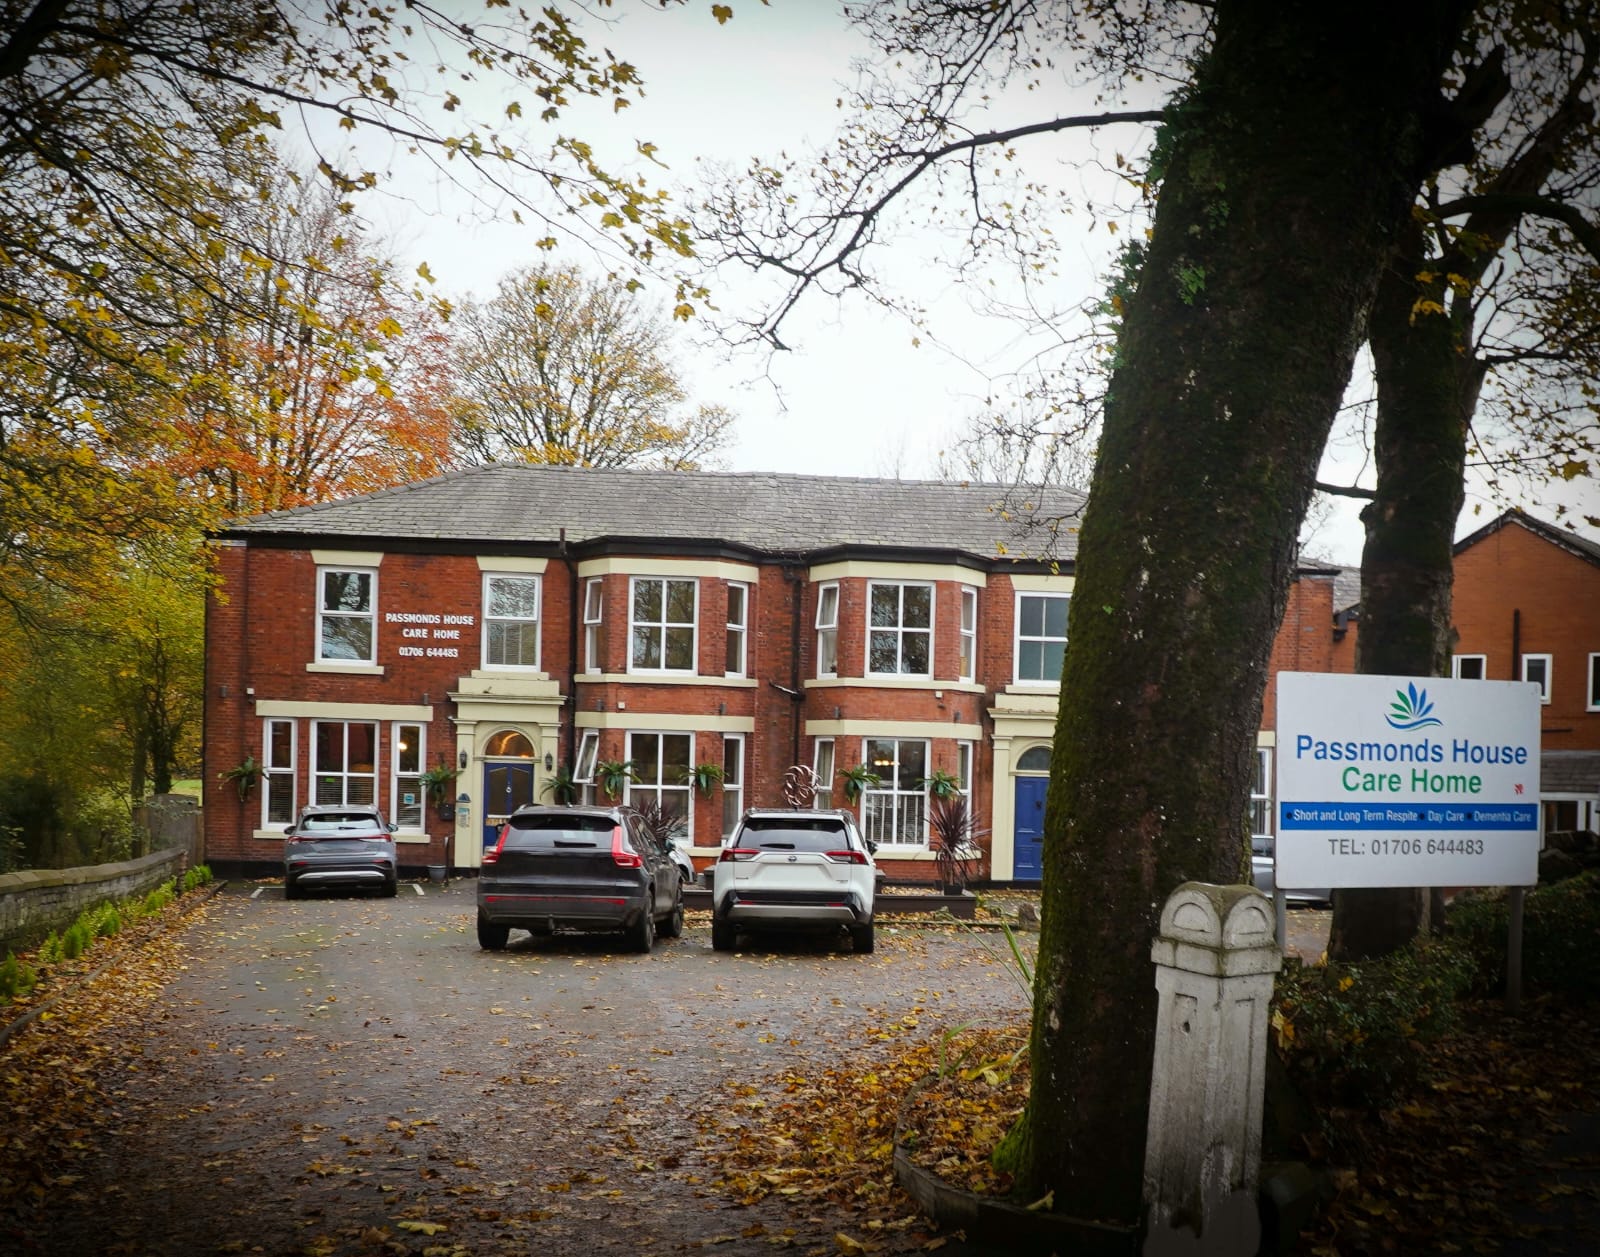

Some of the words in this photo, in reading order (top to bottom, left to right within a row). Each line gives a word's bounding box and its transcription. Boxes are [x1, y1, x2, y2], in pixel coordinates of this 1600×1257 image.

[385, 613, 440, 624] PASSMONDS
[443, 615, 474, 625] HOUSE
[402, 628, 428, 638] CARE
[433, 629, 460, 639] HOME
[399, 646, 424, 657] 01706
[426, 647, 458, 658] 644483
[1296, 735, 1444, 762] Passmonds
[1452, 739, 1528, 764] House
[1342, 766, 1401, 792] Care
[1411, 768, 1482, 793] Home
[1293, 809, 1318, 821] Short
[1320, 810, 1337, 821] and
[1338, 810, 1361, 823] Long
[1362, 810, 1384, 821] Term
[1386, 810, 1418, 823] Respite
[1427, 810, 1443, 823] Day
[1446, 810, 1465, 822] Care
[1473, 811, 1511, 822] Dementia
[1513, 811, 1532, 822] Care
[1328, 839, 1366, 855] TEL:
[1371, 839, 1422, 855] 01706
[1427, 839, 1484, 855] 644483
